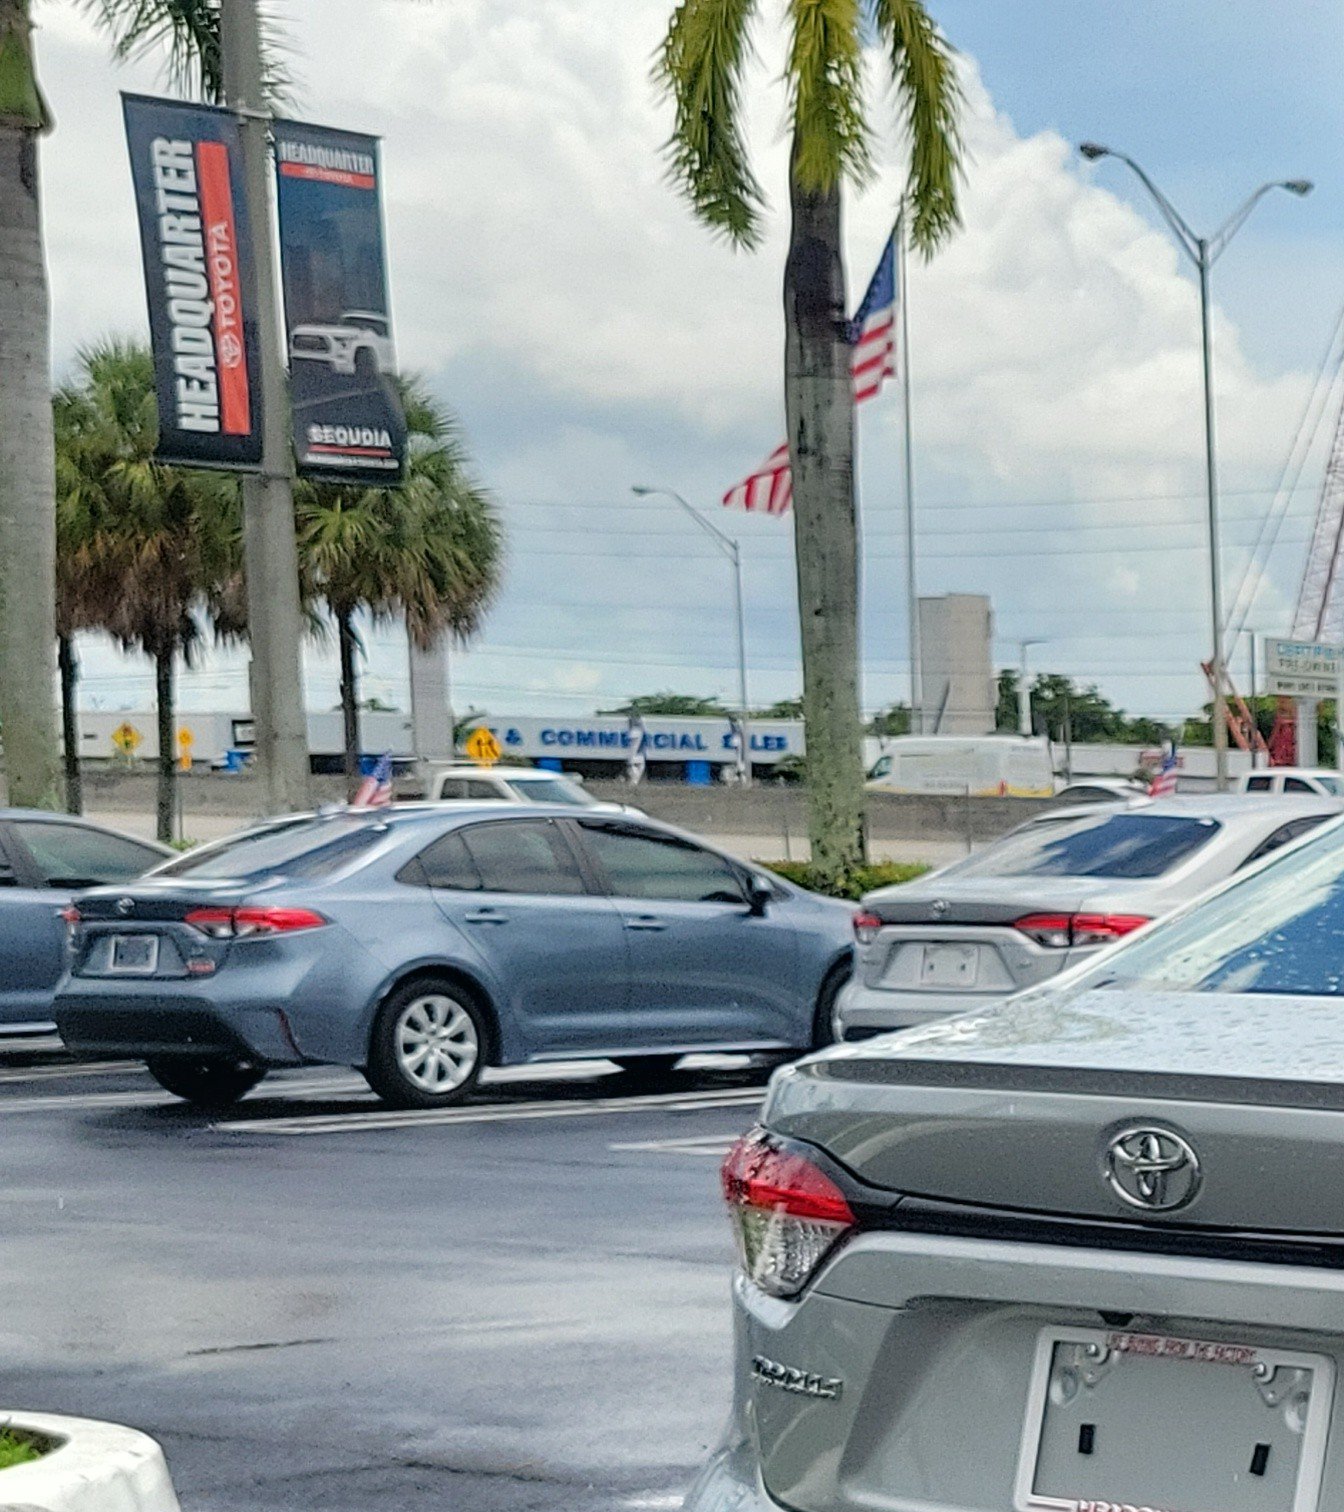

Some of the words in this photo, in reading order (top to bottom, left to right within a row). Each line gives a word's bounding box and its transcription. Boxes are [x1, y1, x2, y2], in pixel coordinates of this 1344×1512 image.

[151, 136, 220, 432] HEADQUARTER
[210, 221, 237, 327] TOYOTA
[722, 733, 788, 751] SLES
